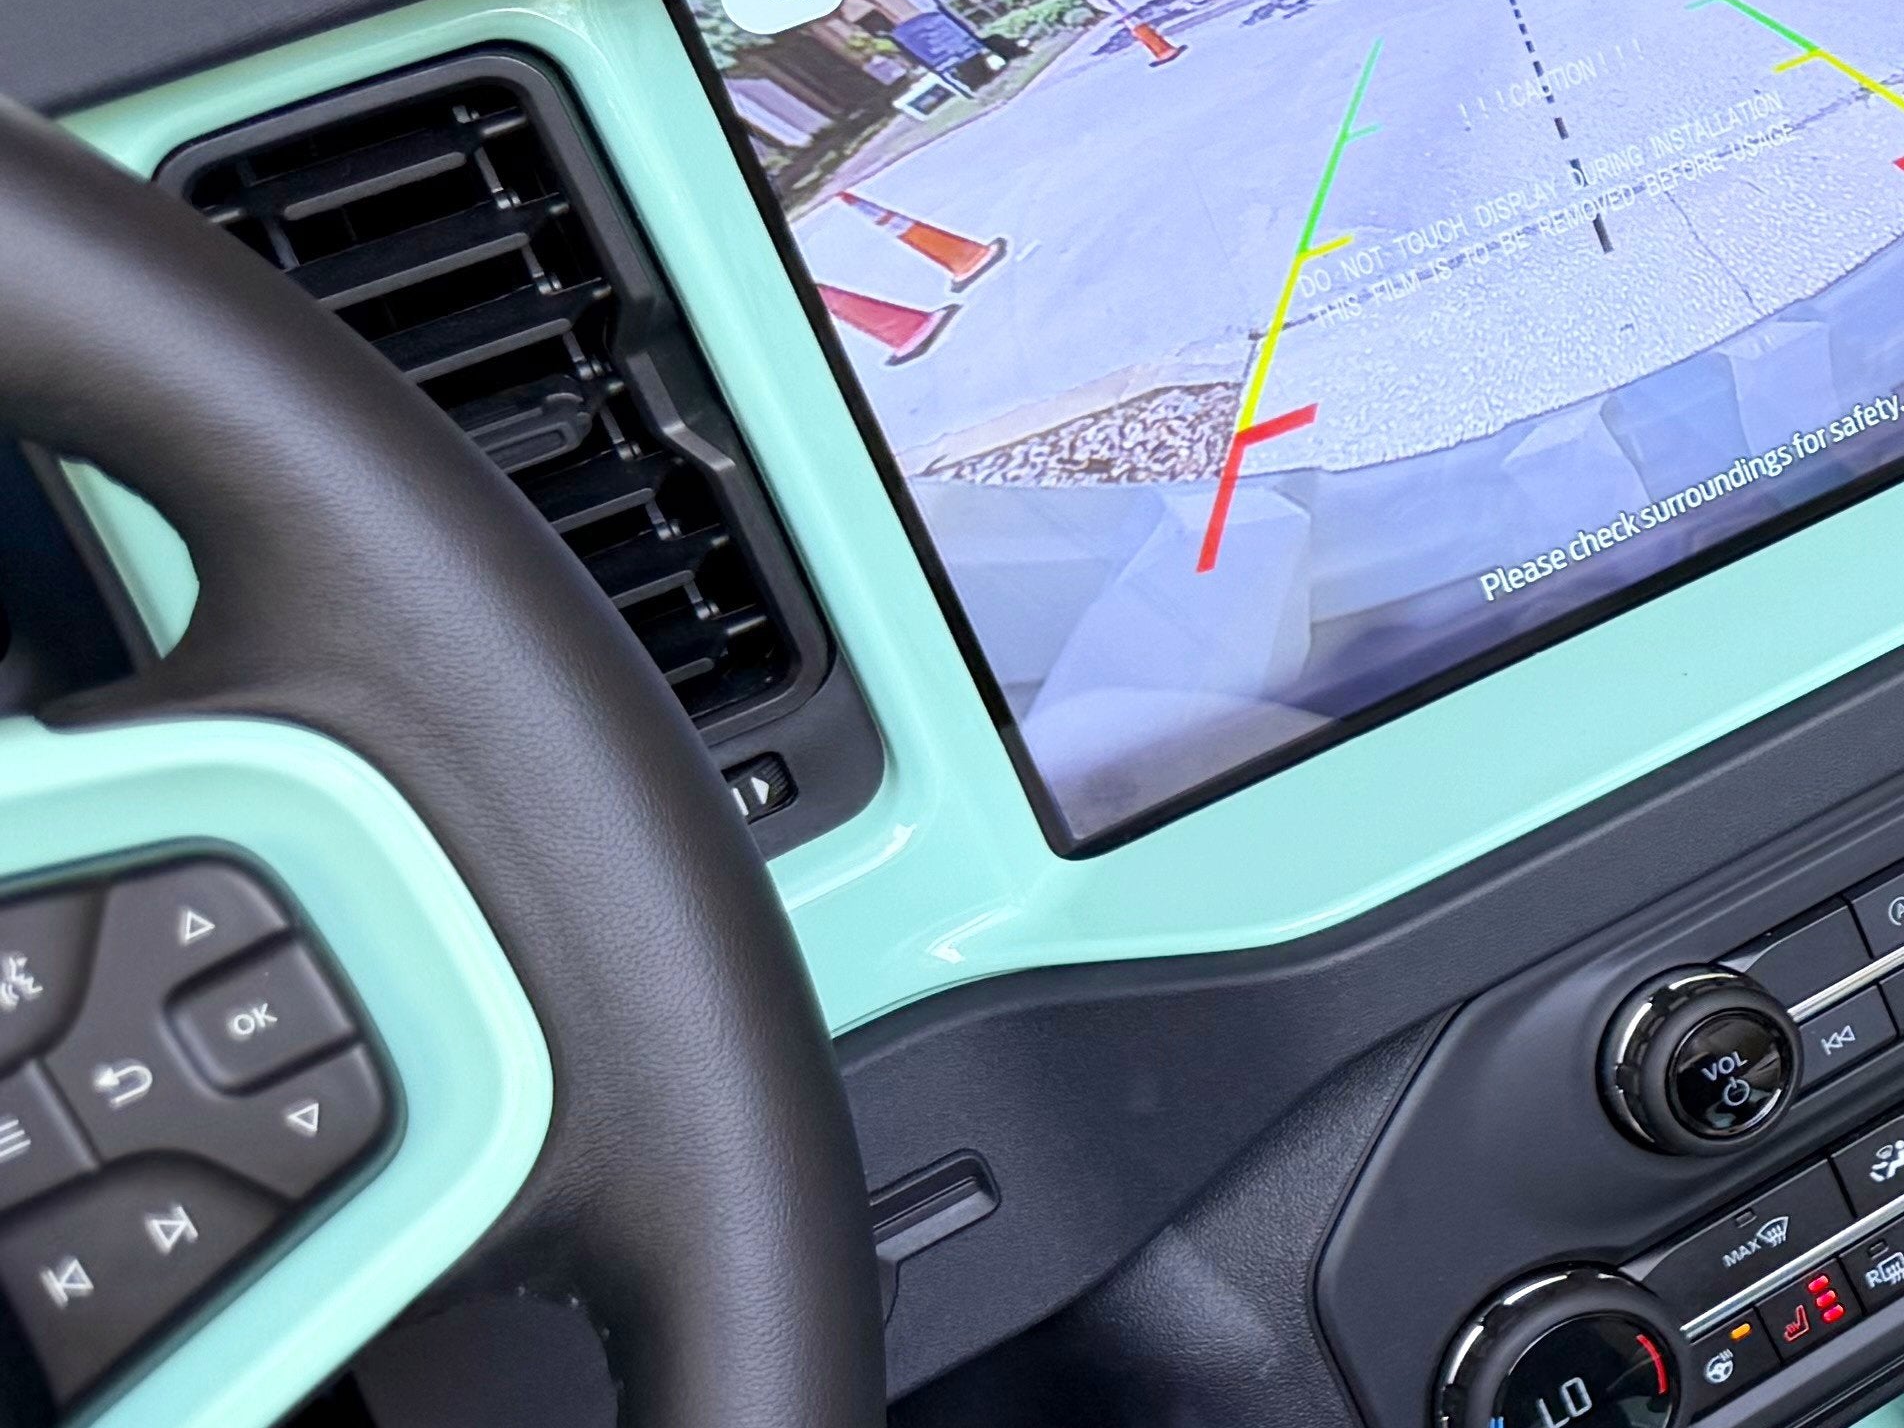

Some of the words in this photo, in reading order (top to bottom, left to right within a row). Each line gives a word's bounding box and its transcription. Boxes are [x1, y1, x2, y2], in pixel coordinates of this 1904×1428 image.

[1300, 269, 1331, 300] DO
[1341, 250, 1383, 288] NOT
[1394, 211, 1468, 259] TOUCH
[1475, 175, 1561, 230] DISPLAY
[1569, 146, 1644, 190] DURING
[1650, 90, 1784, 162] INSTALLATION
[1308, 294, 1363, 330] THIS
[1373, 272, 1422, 307] FILM
[1432, 257, 1455, 284] IS
[1461, 241, 1491, 271] TO
[1499, 226, 1527, 256] BE
[1531, 185, 1639, 244] REMOVED
[1644, 152, 1722, 195] BEFORE
[1731, 121, 1801, 164] USAGE
[1479, 547, 1568, 600] Please
[1568, 511, 1641, 561] check
[1641, 448, 1794, 531] surroundings
[1792, 427, 1829, 459] for
[232, 1002, 278, 1036] OK
[1702, 1050, 1747, 1082] VOL
[1721, 1237, 1761, 1268] MAX
